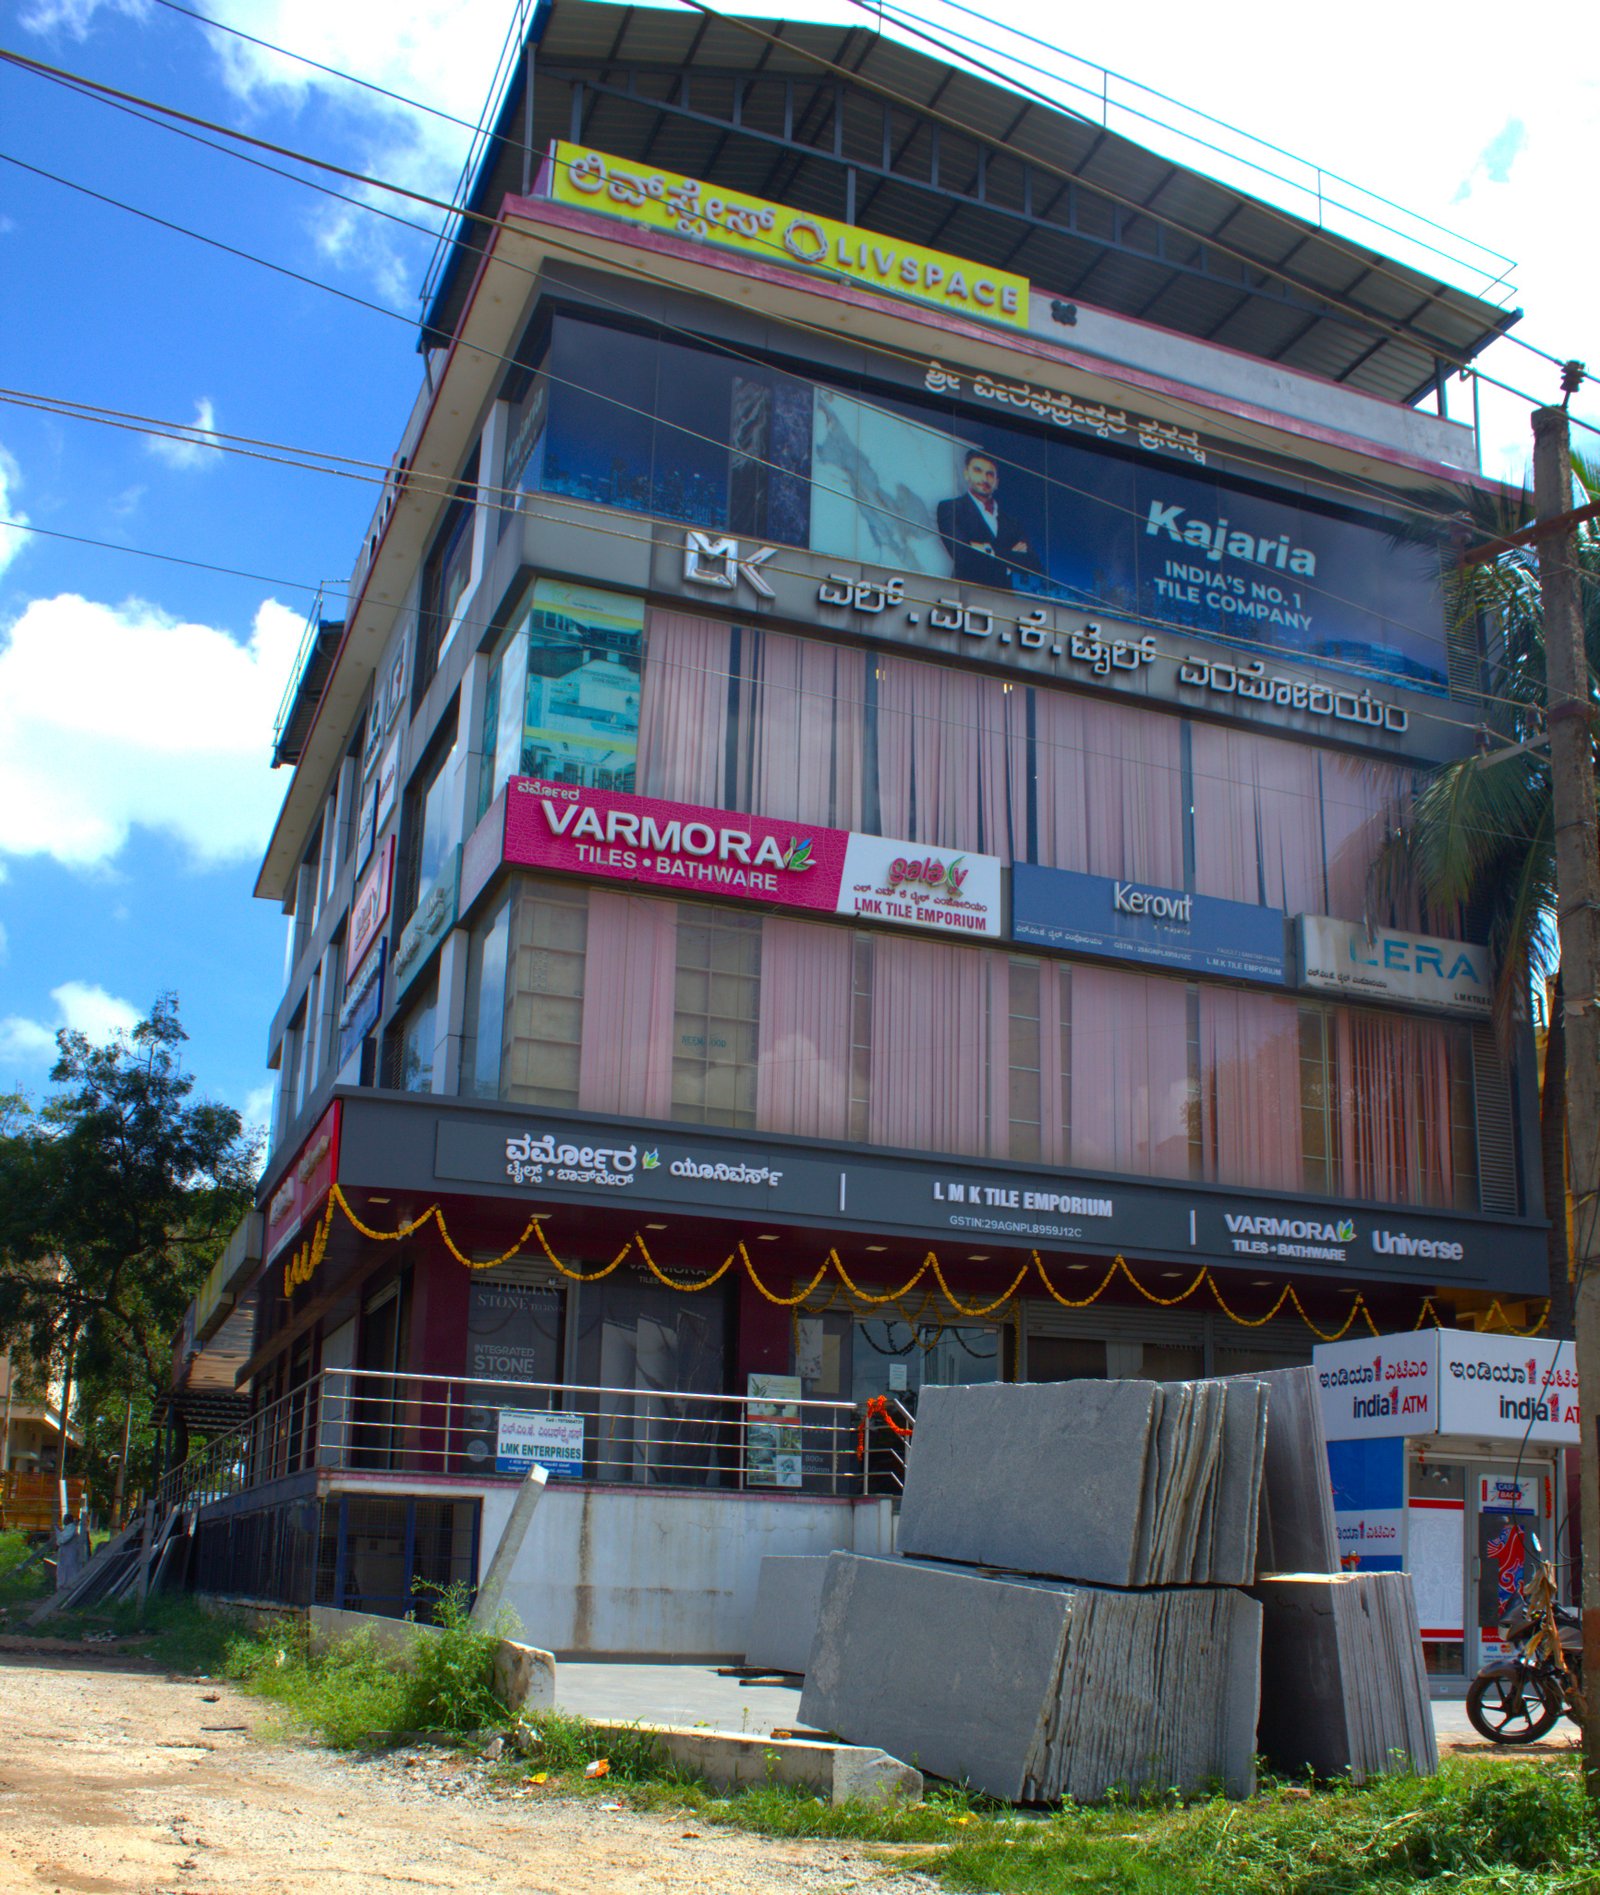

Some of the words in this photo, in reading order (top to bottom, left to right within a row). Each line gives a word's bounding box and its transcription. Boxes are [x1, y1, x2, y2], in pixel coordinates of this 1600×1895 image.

[838, 237, 1019, 313] LIVSPACE
[1146, 500, 1318, 578] Kajaria
[1154, 576, 1200, 605] TILE
[1206, 587, 1313, 631] COMPANY
[1251, 581, 1288, 607] NO.
[541, 799, 784, 869] VARMORA
[577, 843, 637, 870] TILES
[656, 857, 778, 893] BATHWARE
[854, 897, 883, 914] LMK
[886, 902, 912, 919] TILE
[916, 907, 987, 931] EMPORIUM
[1114, 881, 1193, 922] Kerovit
[984, 1187, 1020, 1210] TILE
[1023, 1191, 1113, 1218] EMPORIUM
[1225, 1213, 1337, 1242] VARMORA
[1372, 1230, 1464, 1261] Universe
[1232, 1239, 1270, 1256] TILES
[1278, 1245, 1347, 1262] BATHWARE
[474, 1355, 535, 1374] STONE
[1401, 1395, 1428, 1414] ATM
[500, 1442, 520, 1455] LMK
[521, 1444, 581, 1460] ENTERPRISES
